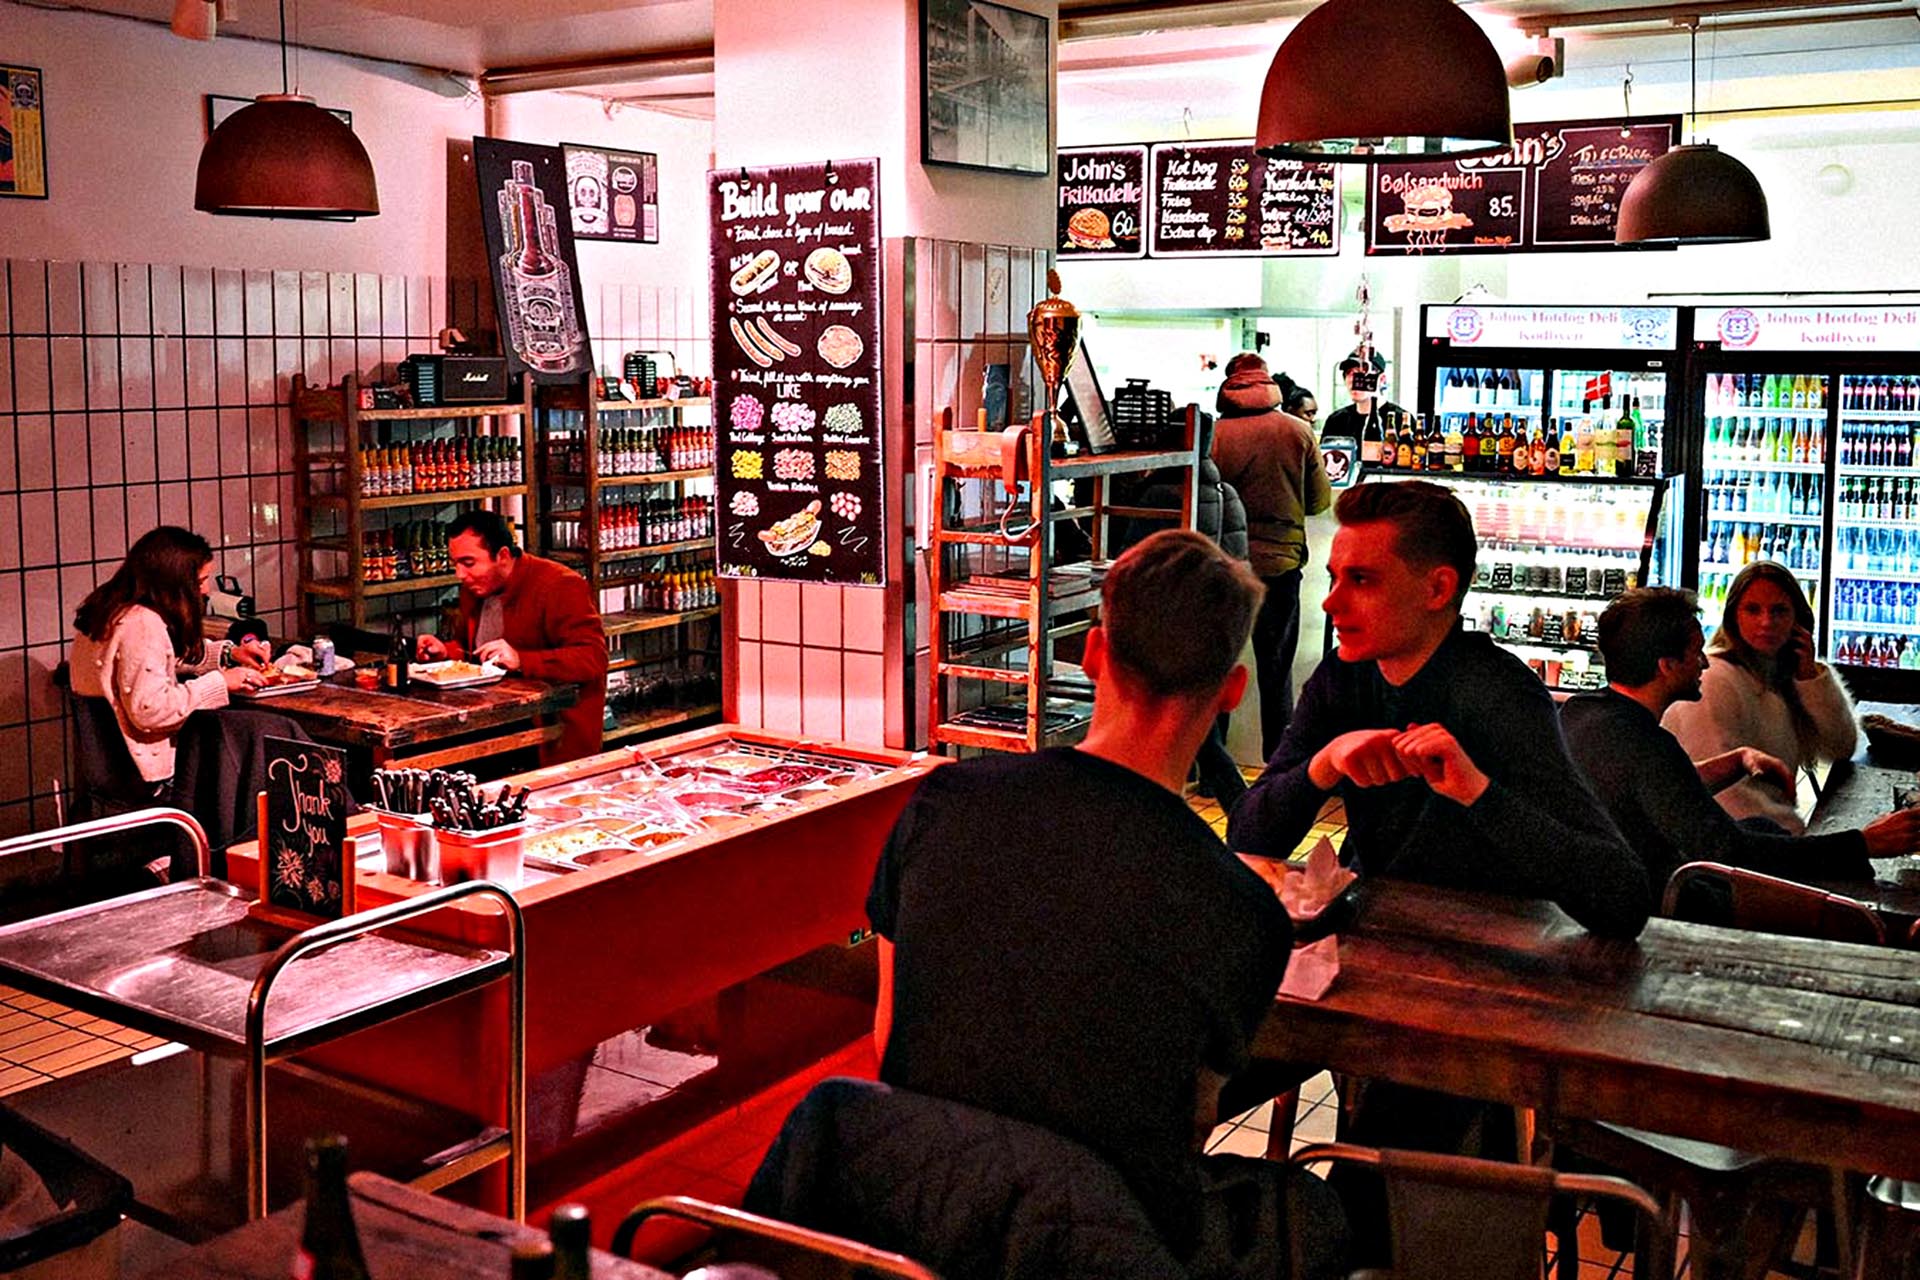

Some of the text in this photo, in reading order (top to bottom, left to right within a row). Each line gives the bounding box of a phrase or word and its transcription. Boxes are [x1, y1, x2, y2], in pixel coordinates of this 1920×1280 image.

[1064, 158, 1126, 181] John's
[1166, 160, 1190, 176] Hot
[1192, 161, 1218, 181] Dog
[718, 180, 780, 222] Build
[784, 189, 826, 226] your
[1059, 182, 1142, 207] Frikadelle
[1161, 193, 1192, 207] Fries
[1160, 226, 1196, 239] Extra
[1197, 225, 1217, 243] dip
[1531, 311, 1586, 325] Hotdog
[1590, 310, 1618, 323] Deli
[1816, 311, 1879, 326] Hotdog
[1883, 311, 1917, 325] Deli
[776, 383, 802, 399] LIKE
[268, 753, 335, 833] Thank
[302, 818, 331, 858] you
